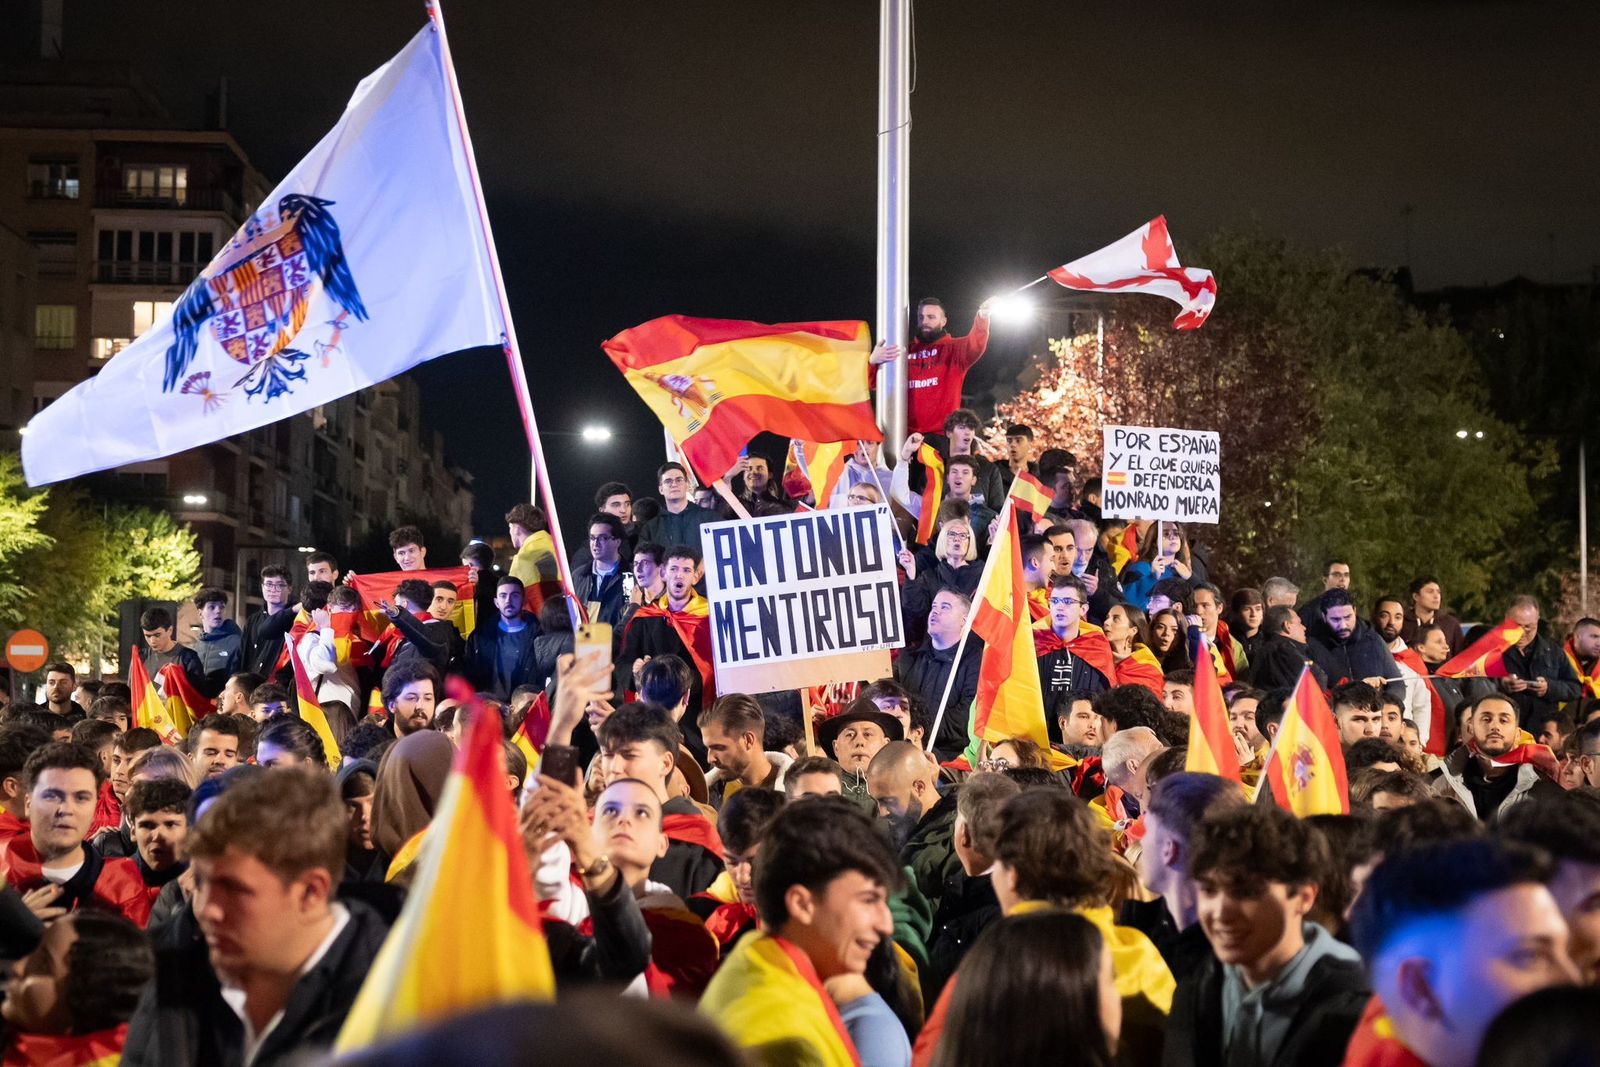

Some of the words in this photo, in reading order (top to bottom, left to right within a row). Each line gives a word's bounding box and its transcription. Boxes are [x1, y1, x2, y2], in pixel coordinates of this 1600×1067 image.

[1114, 429, 1151, 451] POR
[1159, 433, 1217, 456] ESPAÑA
[1109, 452, 1123, 470] Y
[1128, 454, 1144, 471] EL
[1149, 456, 1178, 472] QUE
[1180, 460, 1220, 476] QUIERA
[1133, 473, 1215, 492] DEFENDERLA
[1104, 489, 1169, 511] HONRADO
[1175, 495, 1218, 516] MUERA
[714, 581, 900, 663] MENTIROSO
